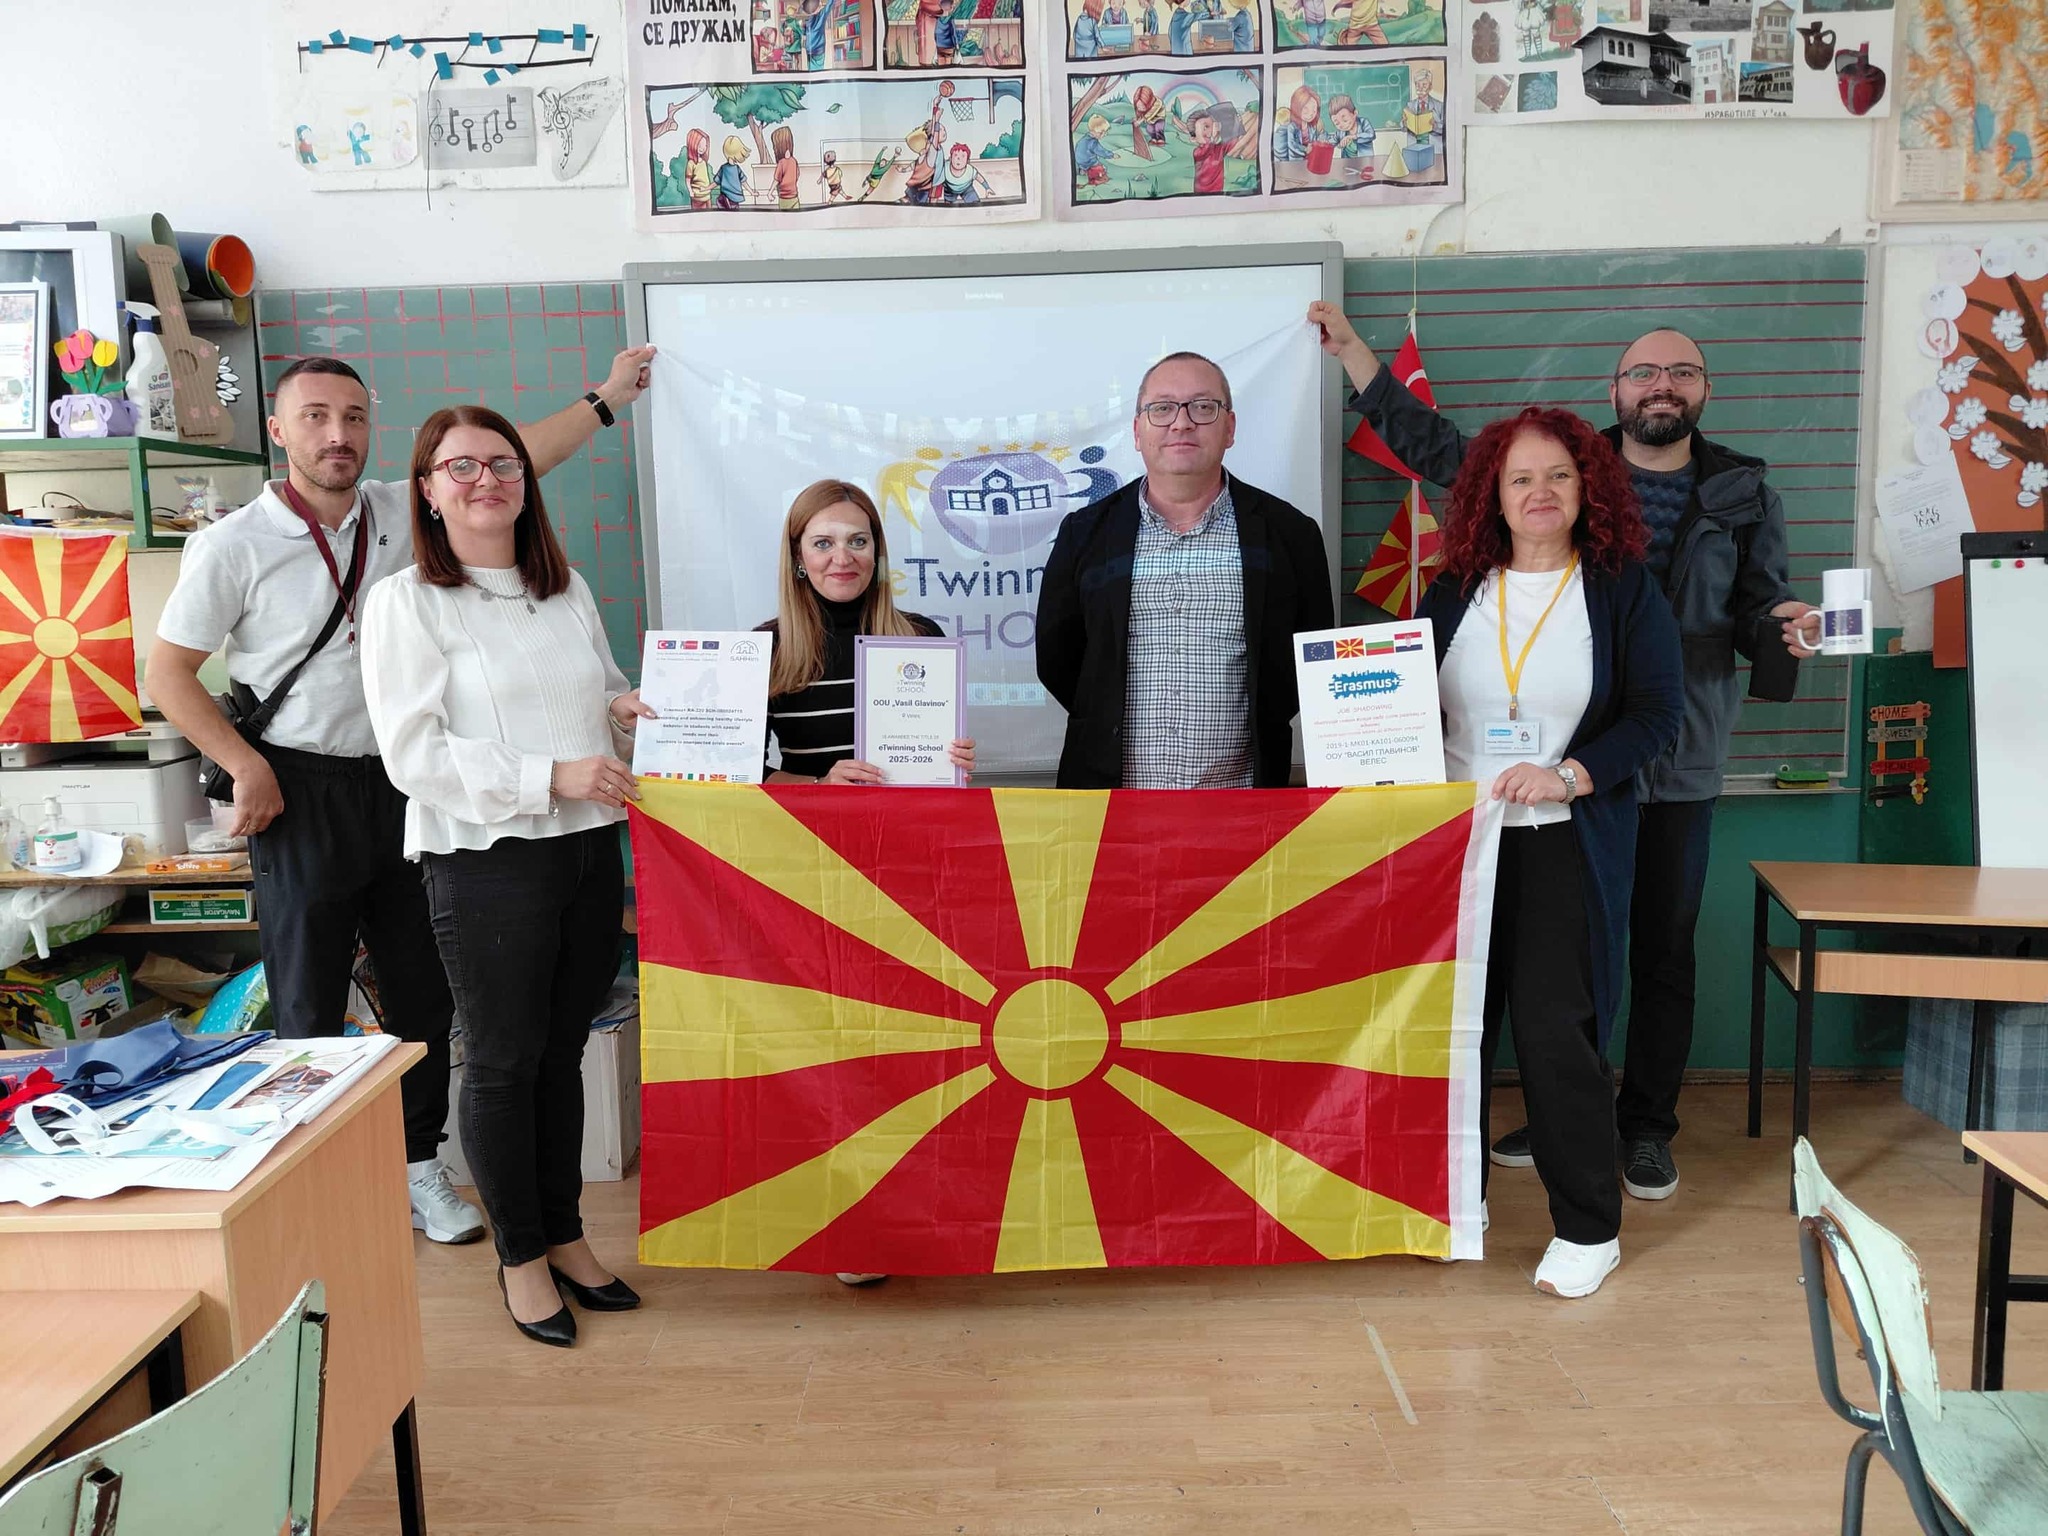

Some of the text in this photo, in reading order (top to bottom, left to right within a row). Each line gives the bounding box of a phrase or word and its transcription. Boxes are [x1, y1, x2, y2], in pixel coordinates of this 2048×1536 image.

[643, 19, 745, 49] СЕ ДРУЖАМ
[890, 558, 1046, 597] eTwinn
[1334, 677, 1400, 693] Erasmus+
[1877, 707, 1909, 720] HOME
[878, 744, 944, 752] eTwinning School
[888, 755, 933, 763] 2025-2026
